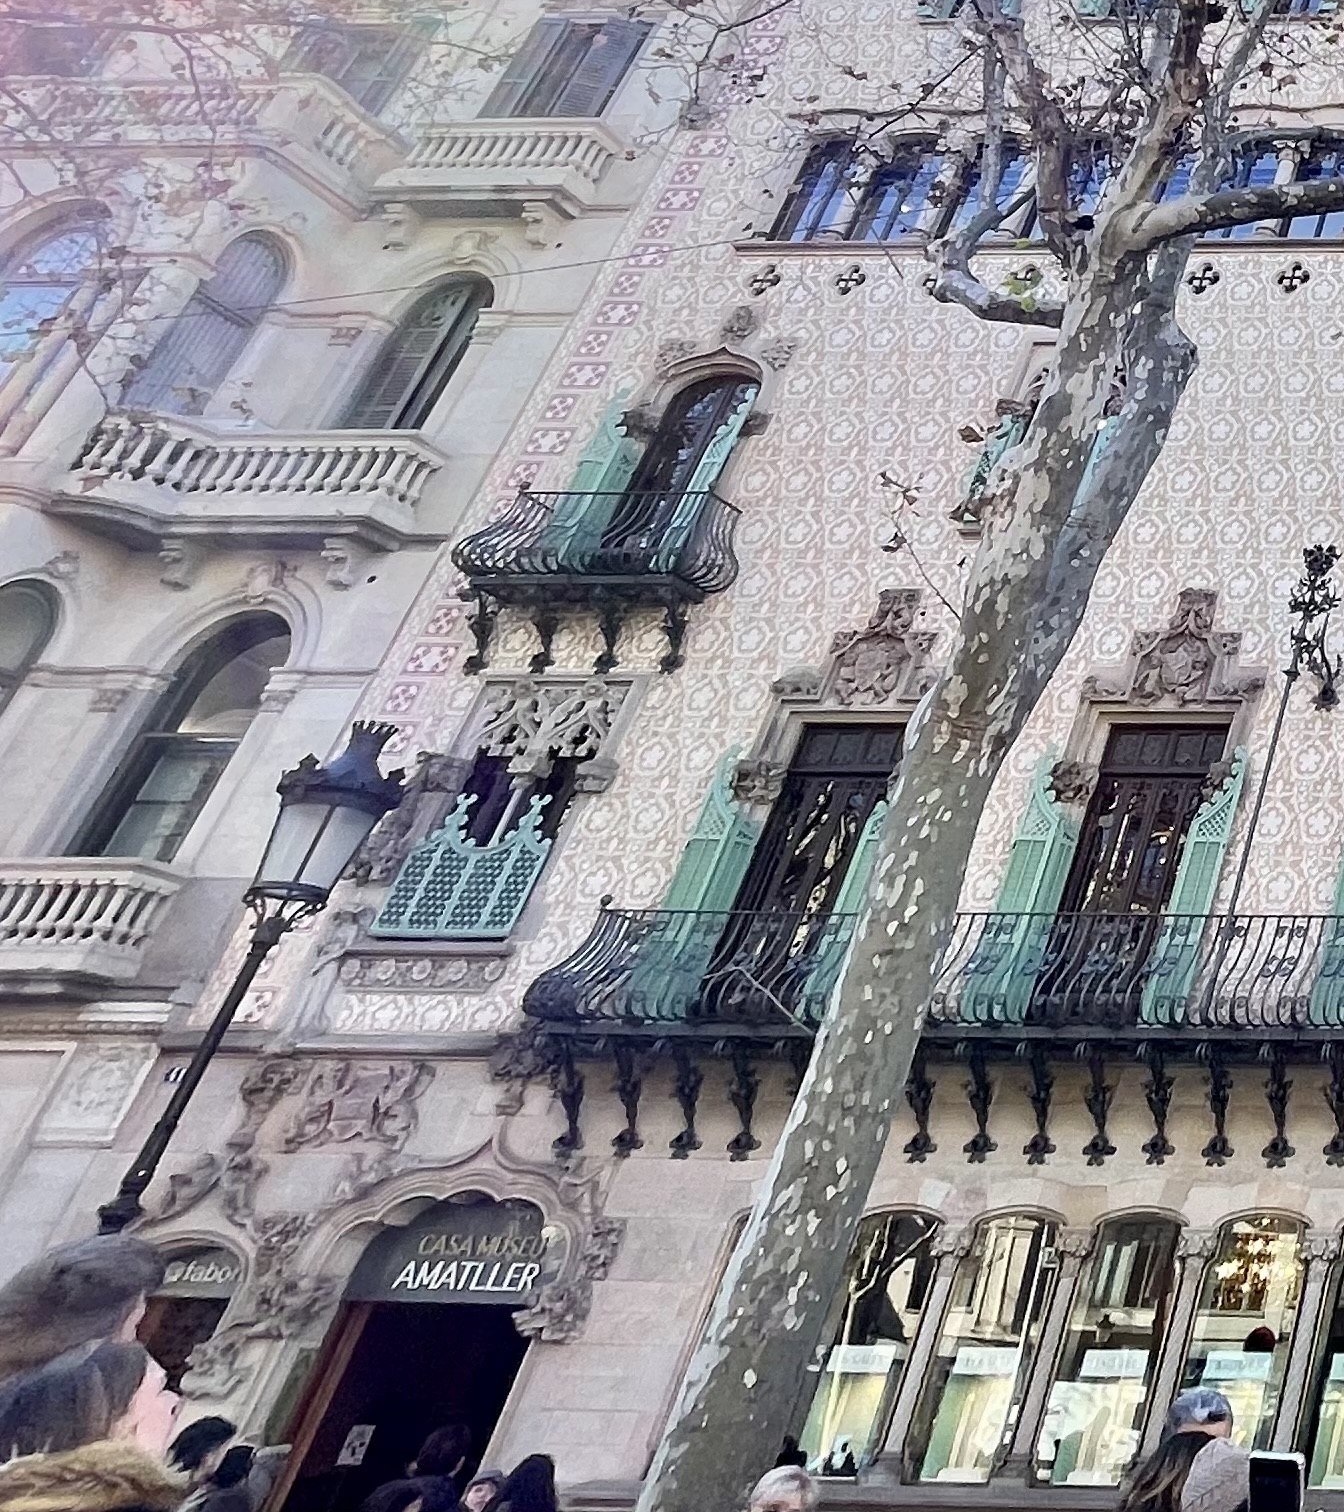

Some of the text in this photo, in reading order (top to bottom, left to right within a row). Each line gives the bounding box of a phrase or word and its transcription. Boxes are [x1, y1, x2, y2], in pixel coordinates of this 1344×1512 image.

[418, 1234, 548, 1259] CASA MUSEU
[390, 1259, 541, 1293] AMATLLER
